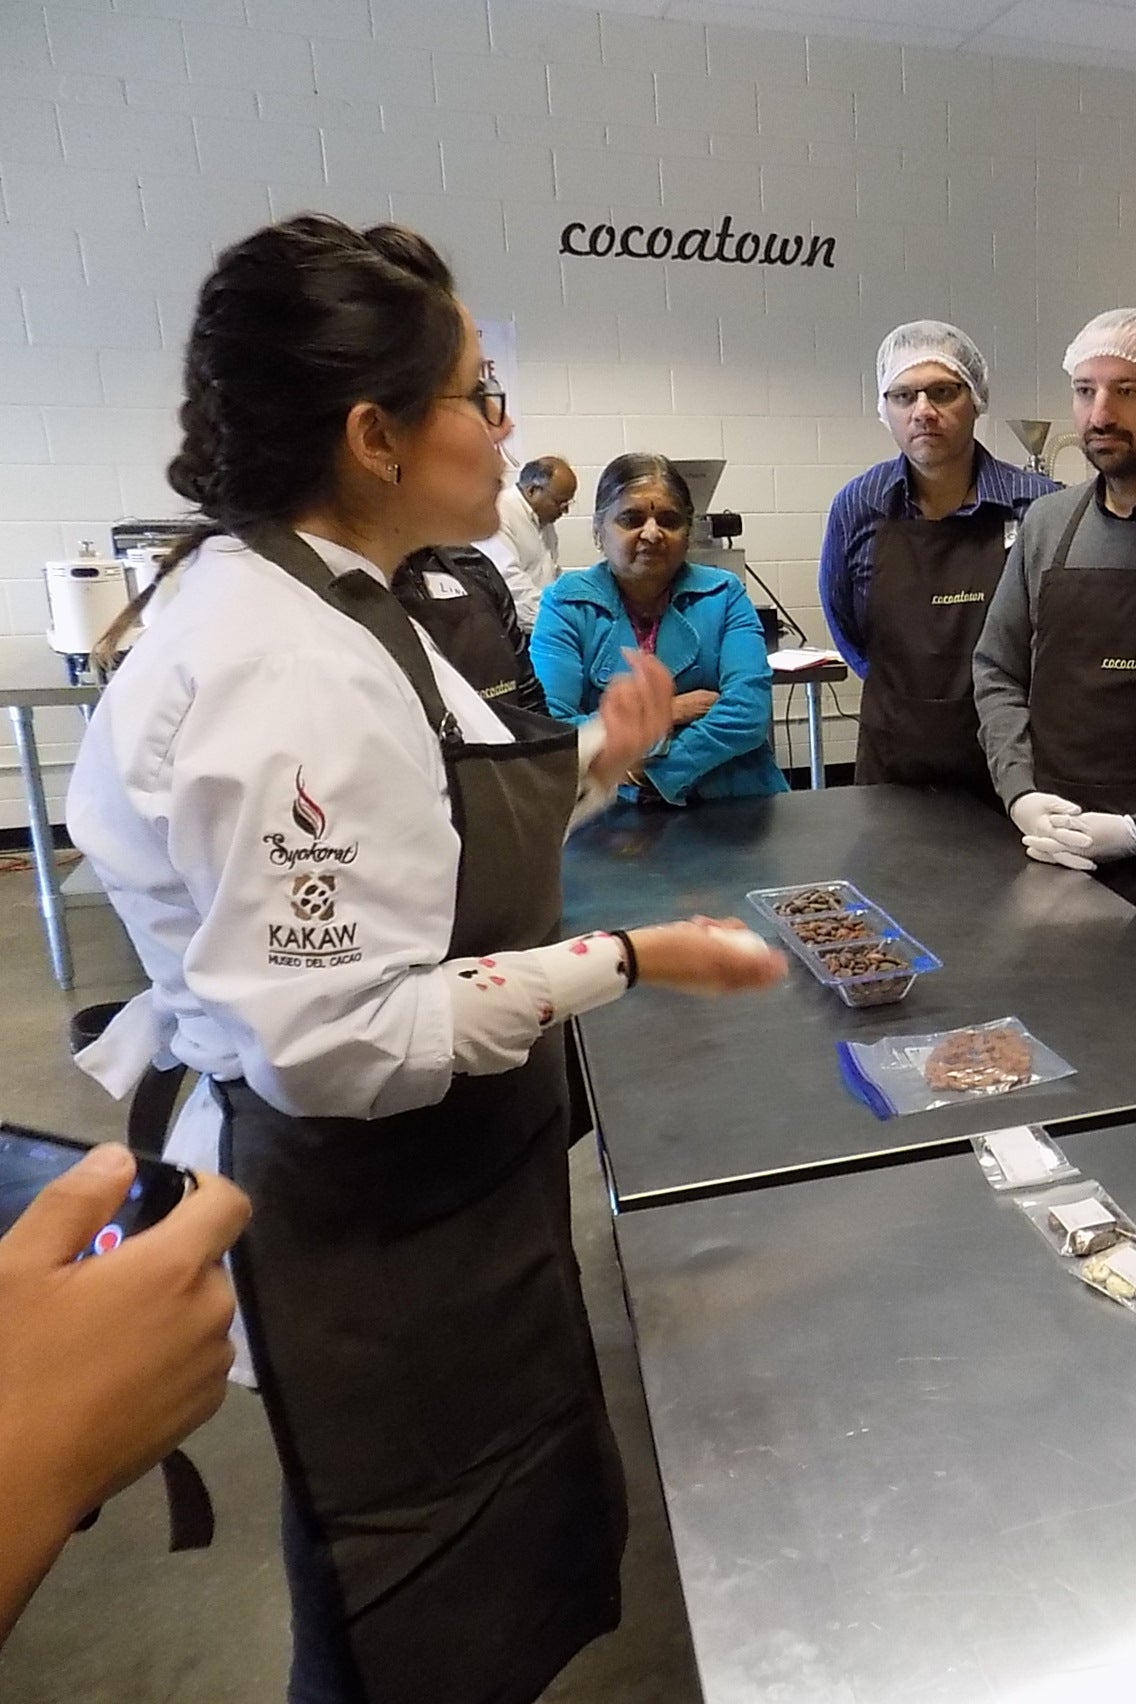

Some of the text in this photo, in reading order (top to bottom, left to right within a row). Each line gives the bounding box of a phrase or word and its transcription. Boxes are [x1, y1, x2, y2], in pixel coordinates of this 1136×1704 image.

[559, 216, 836, 268] cocoatown
[931, 590, 985, 605] cocoatown
[268, 922, 357, 950] KAKAW
[268, 952, 362, 968] MUSEO DEL CACAO
